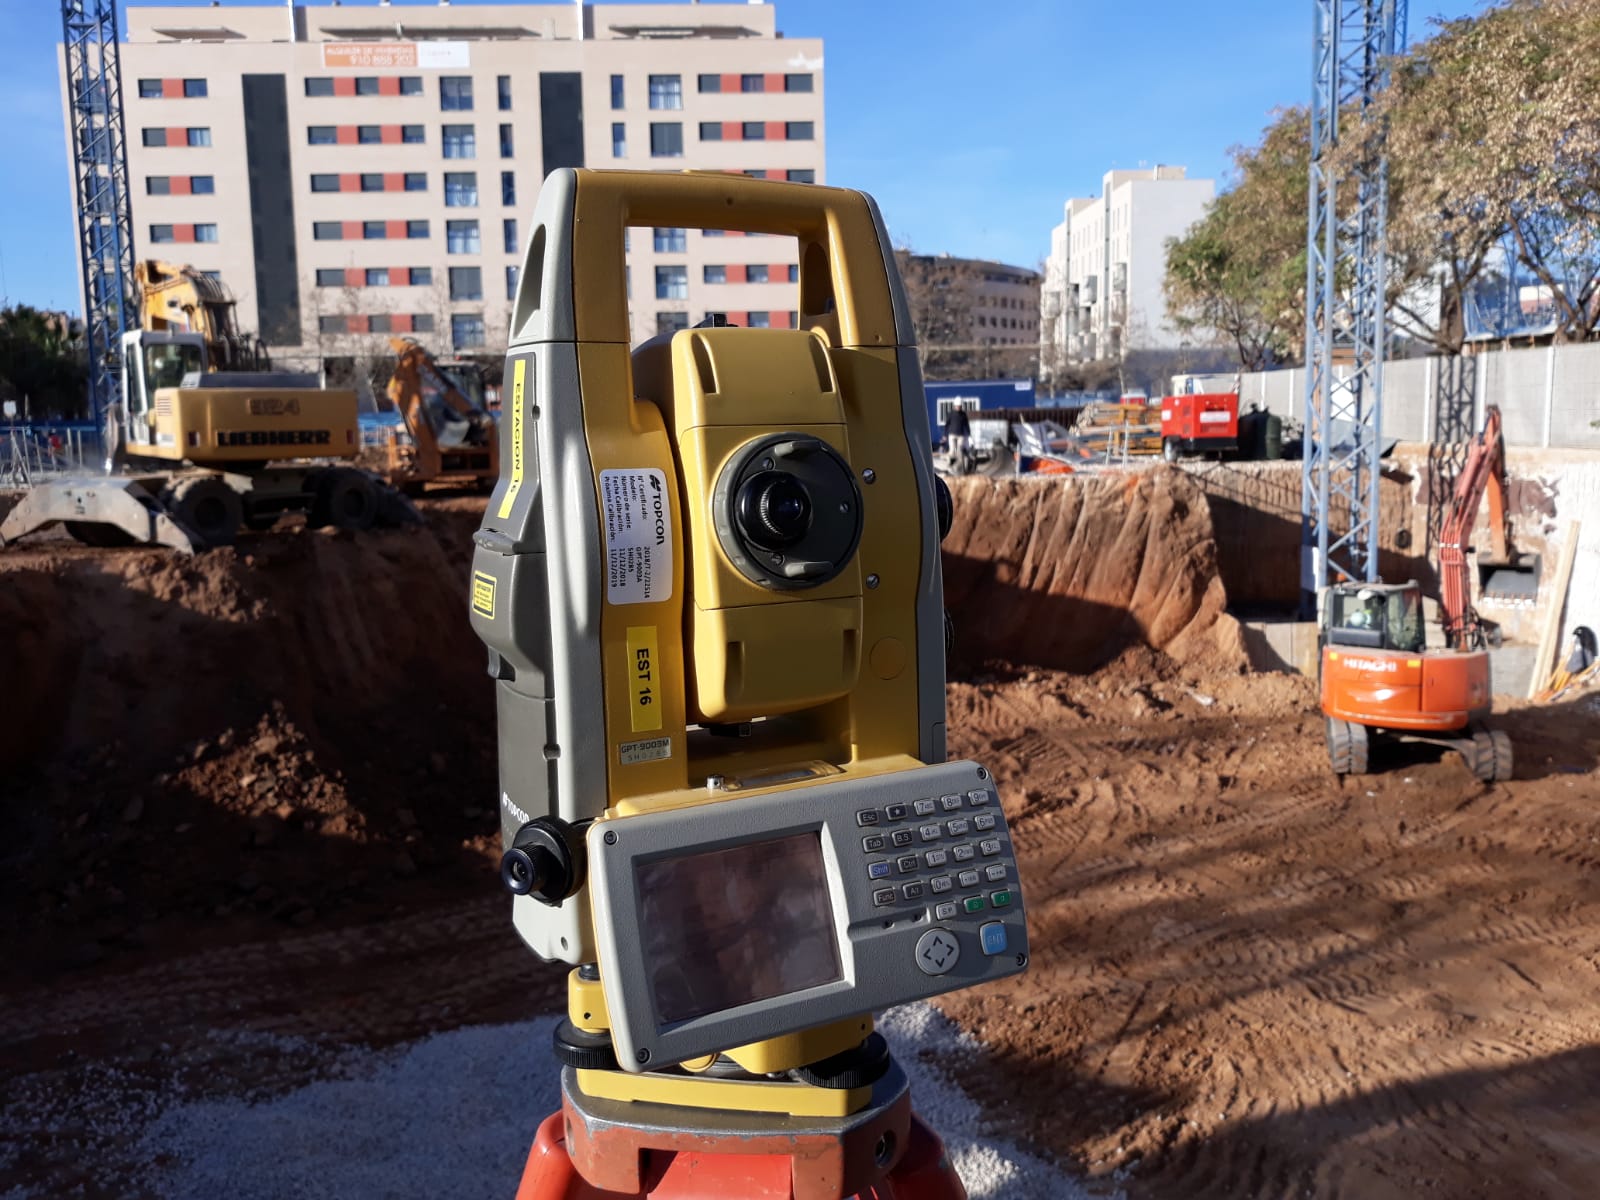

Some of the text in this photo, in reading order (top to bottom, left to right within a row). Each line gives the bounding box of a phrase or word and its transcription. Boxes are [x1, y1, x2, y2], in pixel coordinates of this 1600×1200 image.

[216, 429, 331, 446] LIEBHERR
[621, 475, 629, 502] Número
[624, 502, 631, 511] de
[652, 493, 665, 546] TOPCON
[613, 476, 621, 494] Fecha
[619, 548, 627, 587] 11/12/2018
[610, 548, 618, 588] 11/12/2019
[1343, 658, 1397, 672] HITACHI
[637, 648, 652, 706] EST 16
[862, 813, 876, 822] Esc
[869, 839, 881, 848] Tab
[872, 865, 888, 875] Shift
